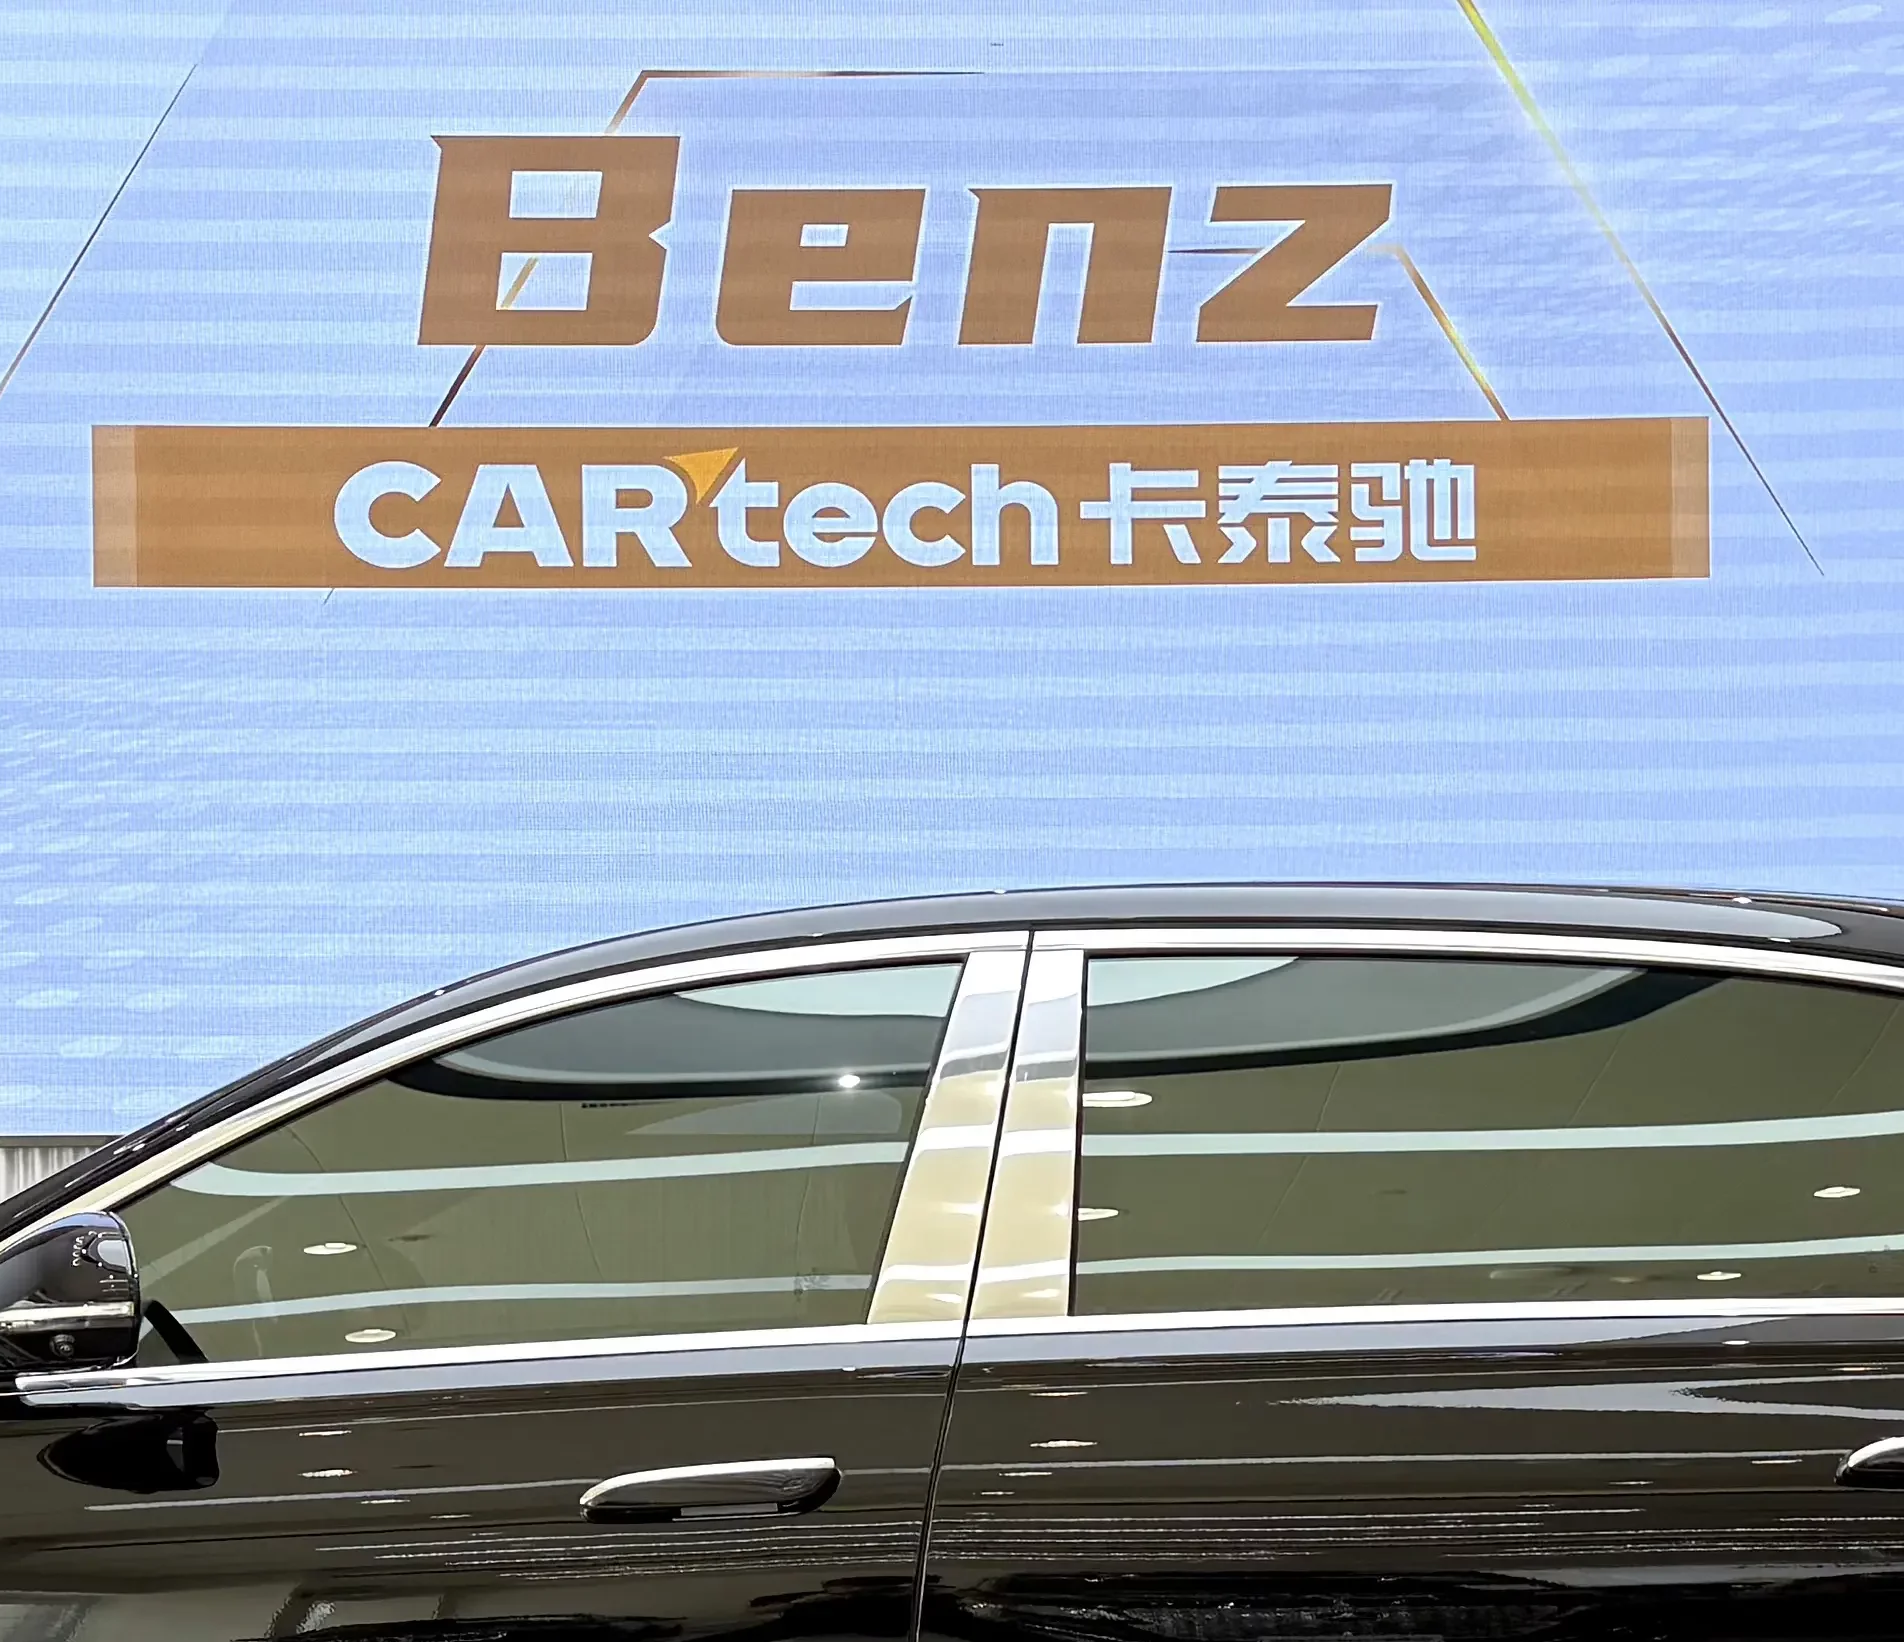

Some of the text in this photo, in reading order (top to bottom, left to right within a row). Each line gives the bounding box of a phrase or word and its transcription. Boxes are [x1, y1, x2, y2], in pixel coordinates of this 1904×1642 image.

[418, 135, 1393, 348] Benz
[333, 457, 1478, 570] CARtech 卡泰驰
